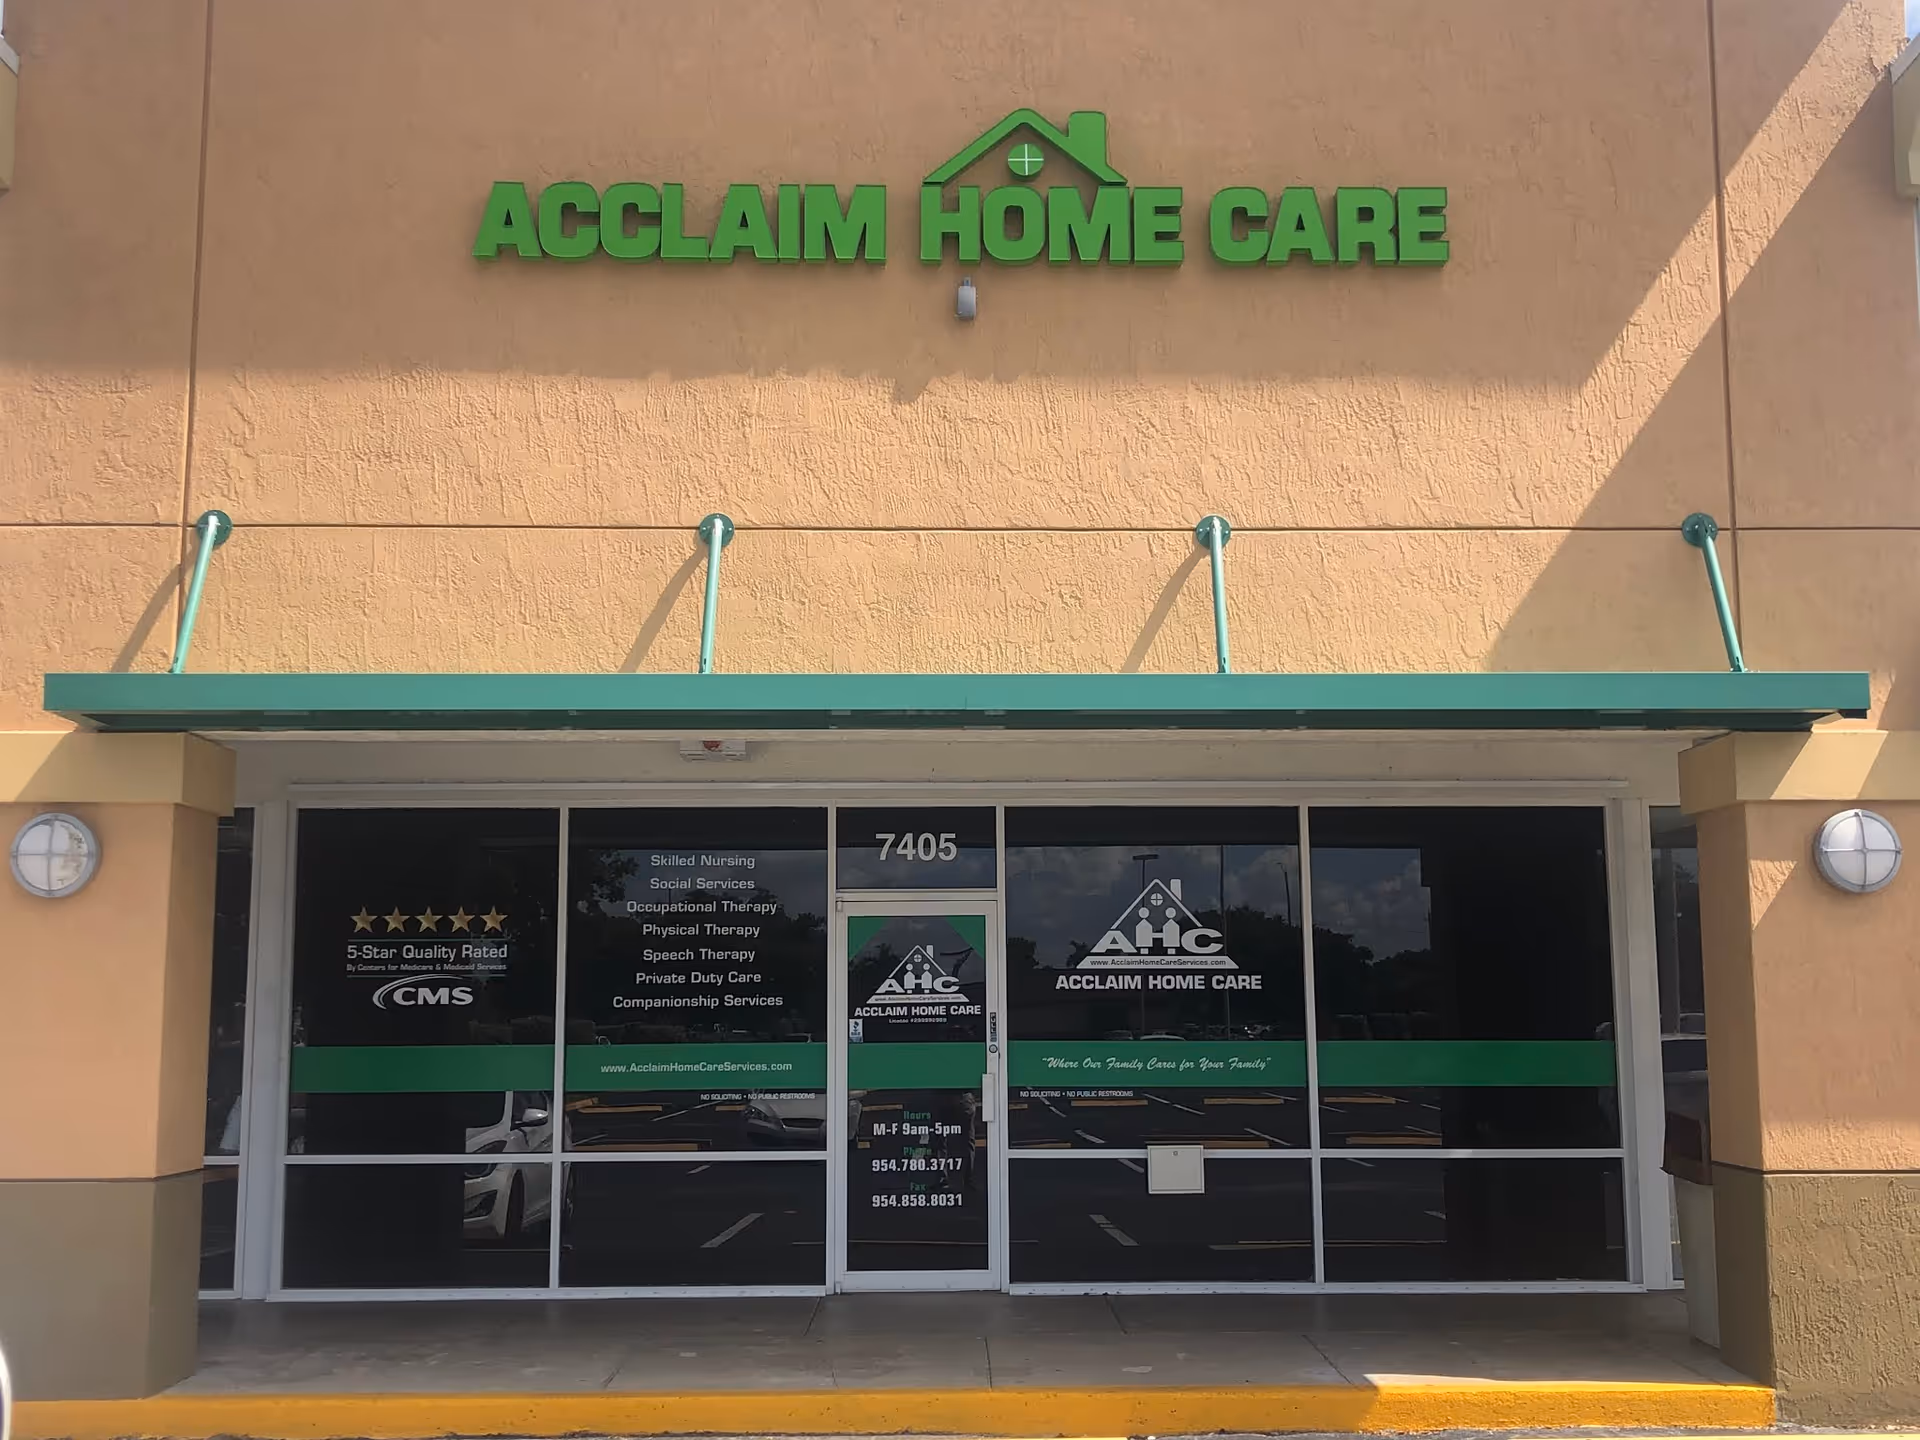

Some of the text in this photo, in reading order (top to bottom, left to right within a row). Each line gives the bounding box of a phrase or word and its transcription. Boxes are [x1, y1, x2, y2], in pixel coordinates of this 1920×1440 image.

[472, 181, 1450, 267] ACCLAIM HOME CARE
[875, 832, 958, 862] 7405
[650, 854, 756, 869] Skilled Nursing
[650, 877, 755, 890] Social Services
[627, 899, 778, 916] Occupational Therapy
[643, 923, 760, 938] Physical Therapy
[1090, 918, 1224, 955] AHC
[347, 944, 508, 962] 5-Star Quality Rated
[643, 948, 756, 963] Speech Therapy
[443, 963, 475, 971] Medicaid
[476, 963, 507, 971] Services
[1089, 959, 1227, 967] www.AcclaimHomeCareServices.com
[636, 971, 762, 986] Private Duty Care
[875, 970, 960, 994] AHC
[1055, 975, 1262, 990] ACCLAIM HOME CARE
[393, 987, 474, 1006] CMS
[613, 994, 783, 1010] Companionship Services
[854, 1005, 982, 1017] ACCLAIM HOME CARE
[600, 1062, 792, 1074] www.AcclaimHomeCareServices.com
[1082, 1057, 1102, 1069] Our
[1106, 1056, 1143, 1071] Family
[1146, 1056, 1176, 1070] Cares
[1178, 1057, 1195, 1071] for
[1199, 1056, 1224, 1071] Your
[873, 1122, 961, 1137] M-F 9am-5pm
[872, 1158, 962, 1171] 954.780.3717
[872, 1194, 962, 1207] 954.858.8031
